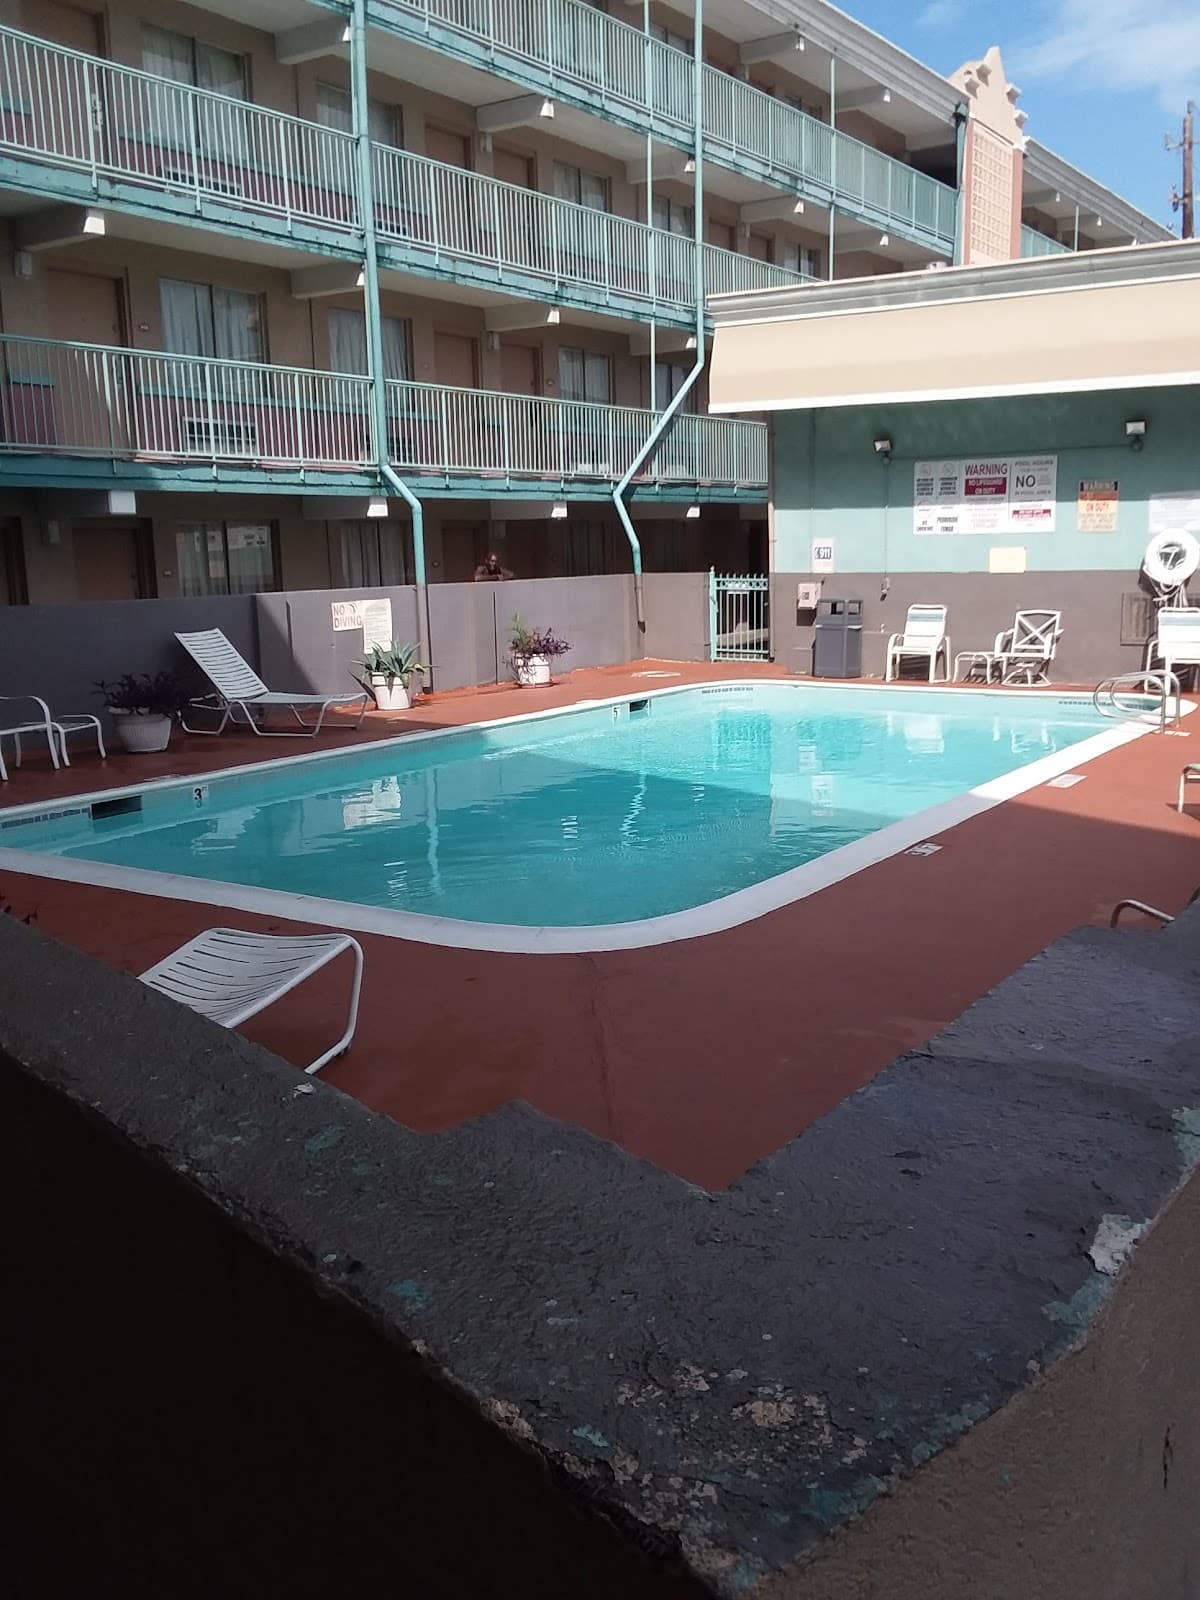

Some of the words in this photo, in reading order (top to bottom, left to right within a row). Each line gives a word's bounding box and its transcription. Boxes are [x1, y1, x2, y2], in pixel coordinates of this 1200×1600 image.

[965, 463, 1008, 475] WARNING
[1015, 474, 1036, 488] NO
[333, 604, 345, 616] NO
[334, 615, 362, 628] DIVING
